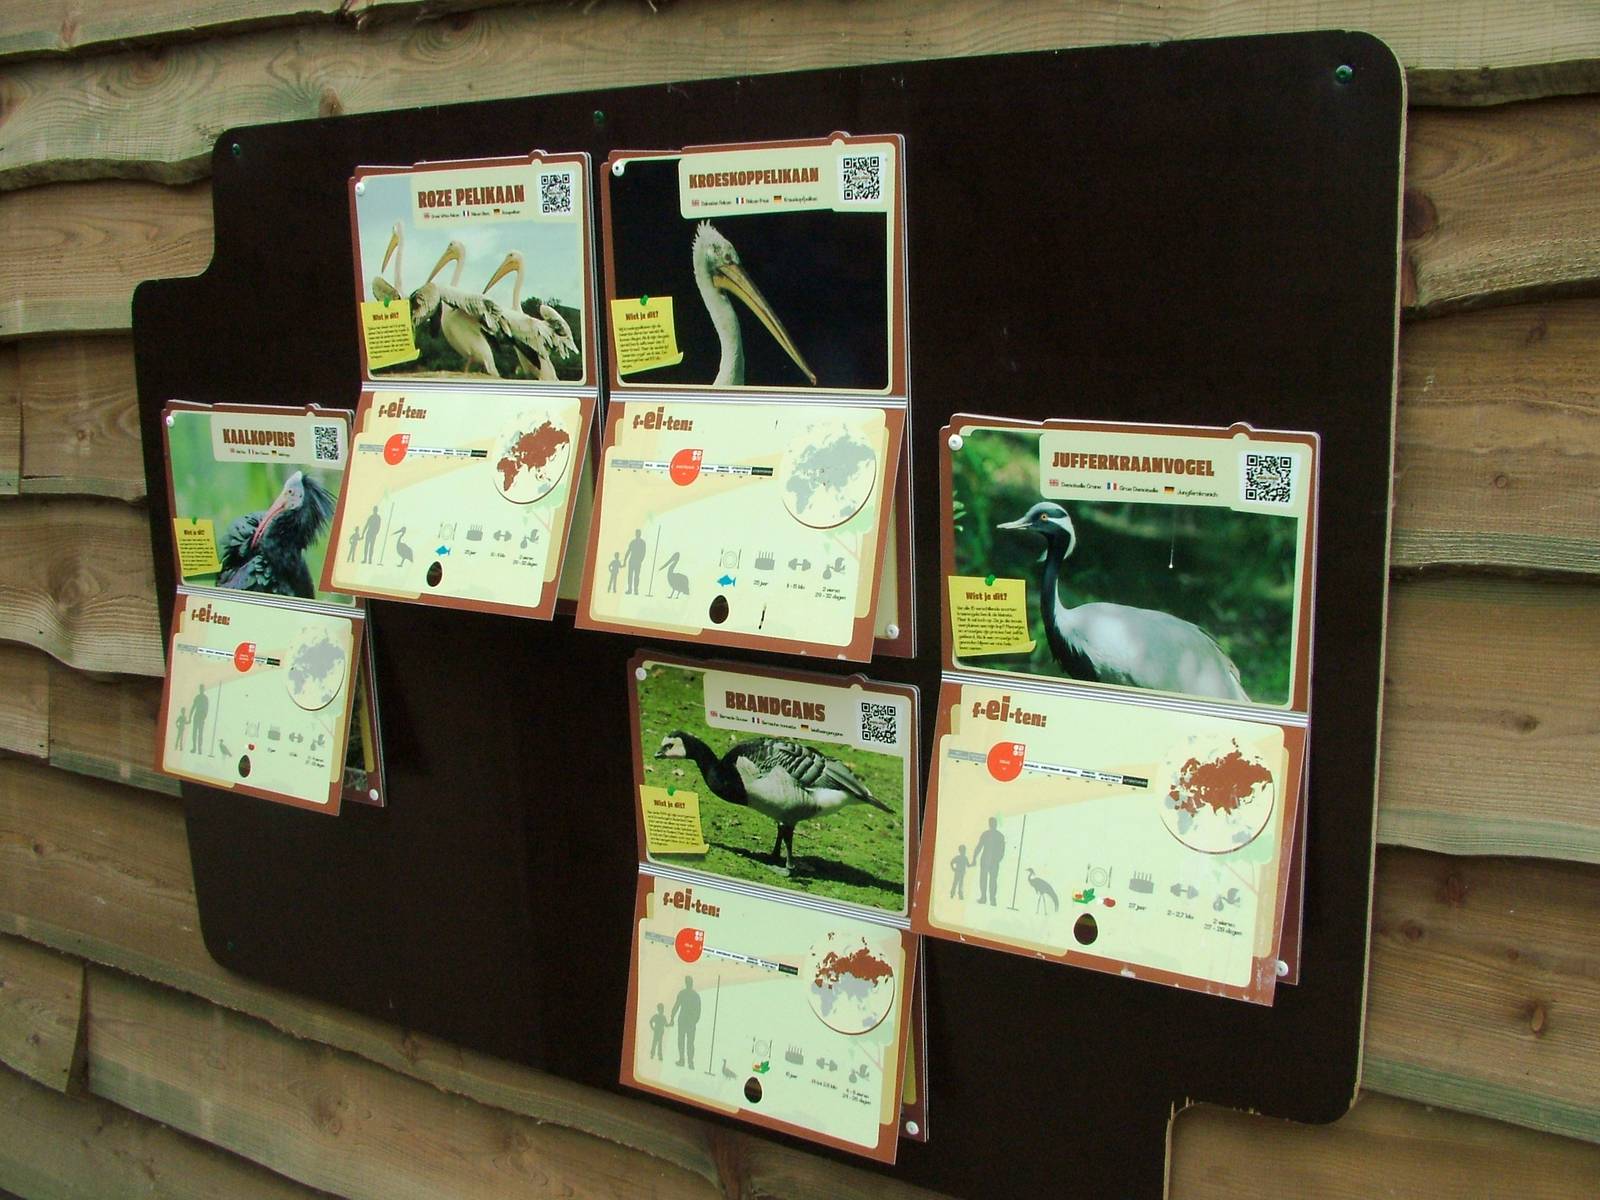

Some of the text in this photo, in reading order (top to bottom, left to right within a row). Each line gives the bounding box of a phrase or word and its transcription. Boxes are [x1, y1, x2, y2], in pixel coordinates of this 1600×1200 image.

[688, 167, 819, 189] KROESKOPPELIKAAN
[417, 184, 526, 209] ROZE PELIKAAN
[222, 428, 296, 448] KAALKOPIBIS
[1052, 451, 1215, 477] JUFFERKRAANVOGEL
[965, 591, 1008, 602] Wist je dit?
[725, 690, 826, 722] BRANDGANS
